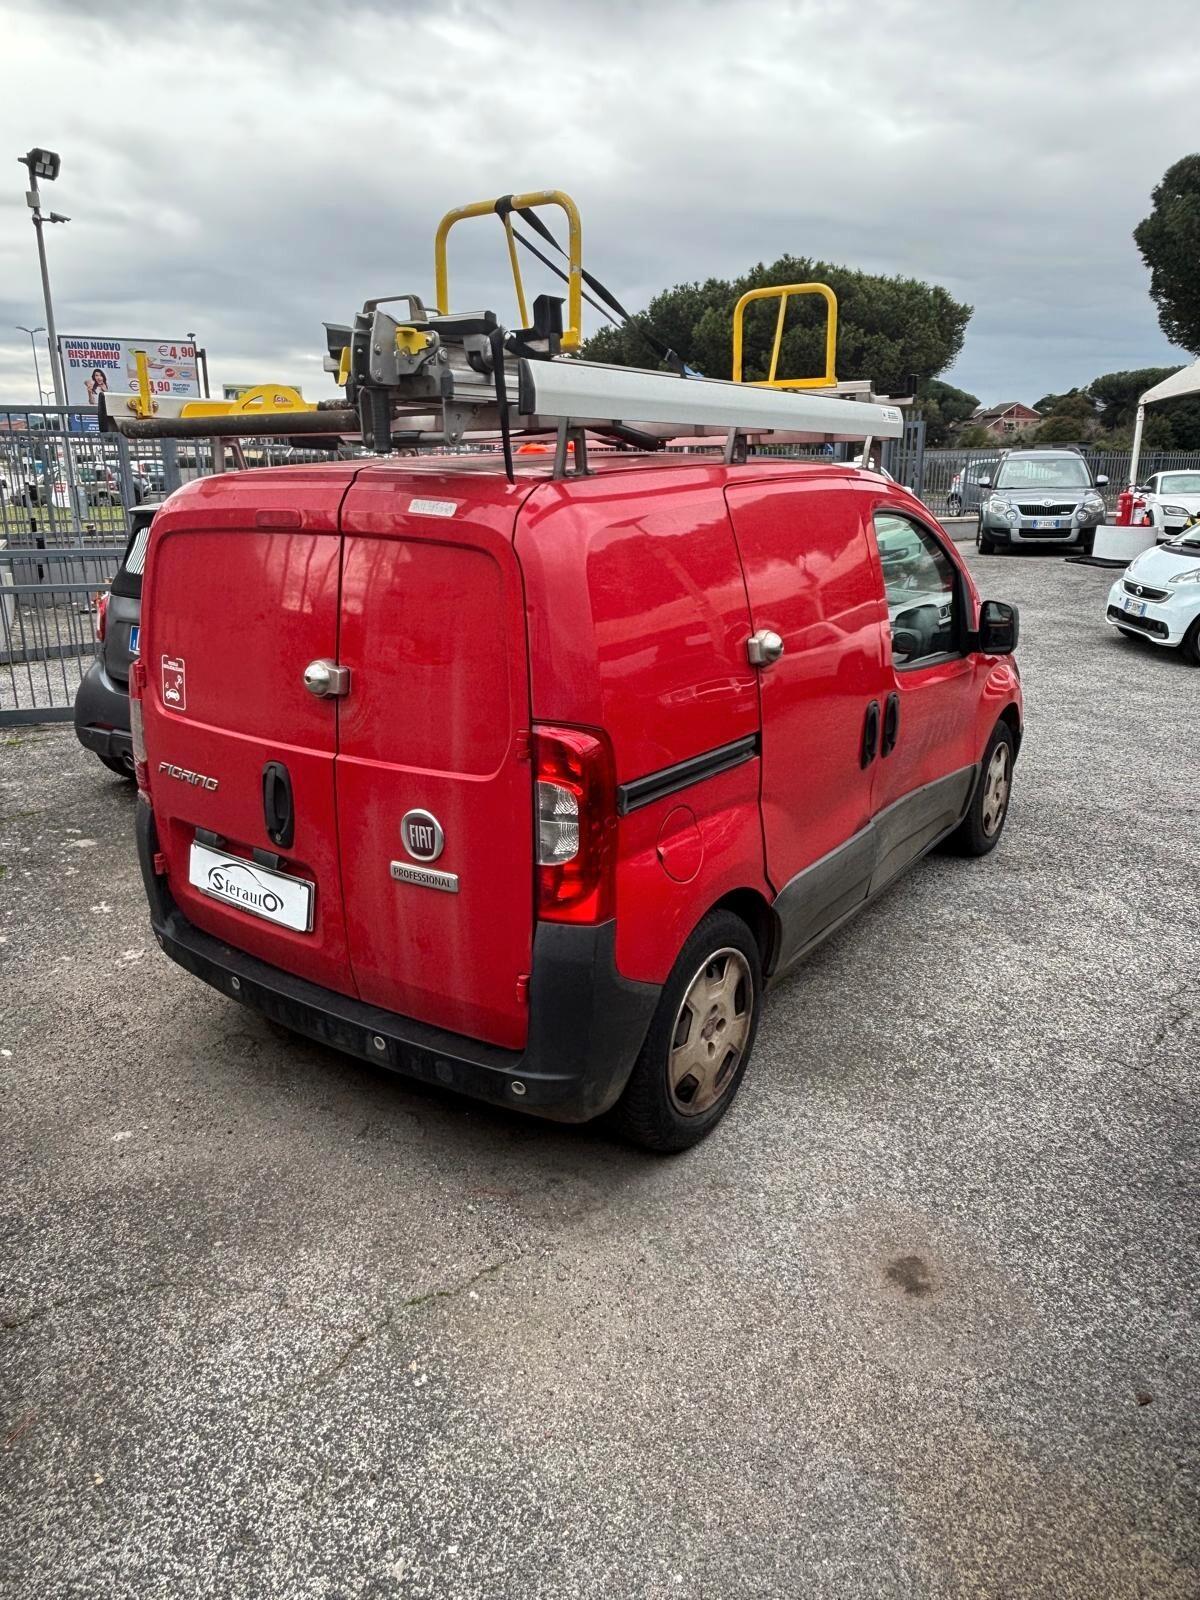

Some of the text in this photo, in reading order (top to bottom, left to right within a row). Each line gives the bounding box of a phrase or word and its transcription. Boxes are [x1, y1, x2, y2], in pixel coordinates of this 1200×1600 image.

[65, 341, 121, 351] ANNO NUOVO
[68, 350, 120, 360] RISPARMIO
[70, 360, 121, 369] DI SEMPRE.
[159, 761, 218, 791] FIORINO
[409, 824, 433, 849] FIAT
[393, 867, 452, 888] PROFESSIONAL
